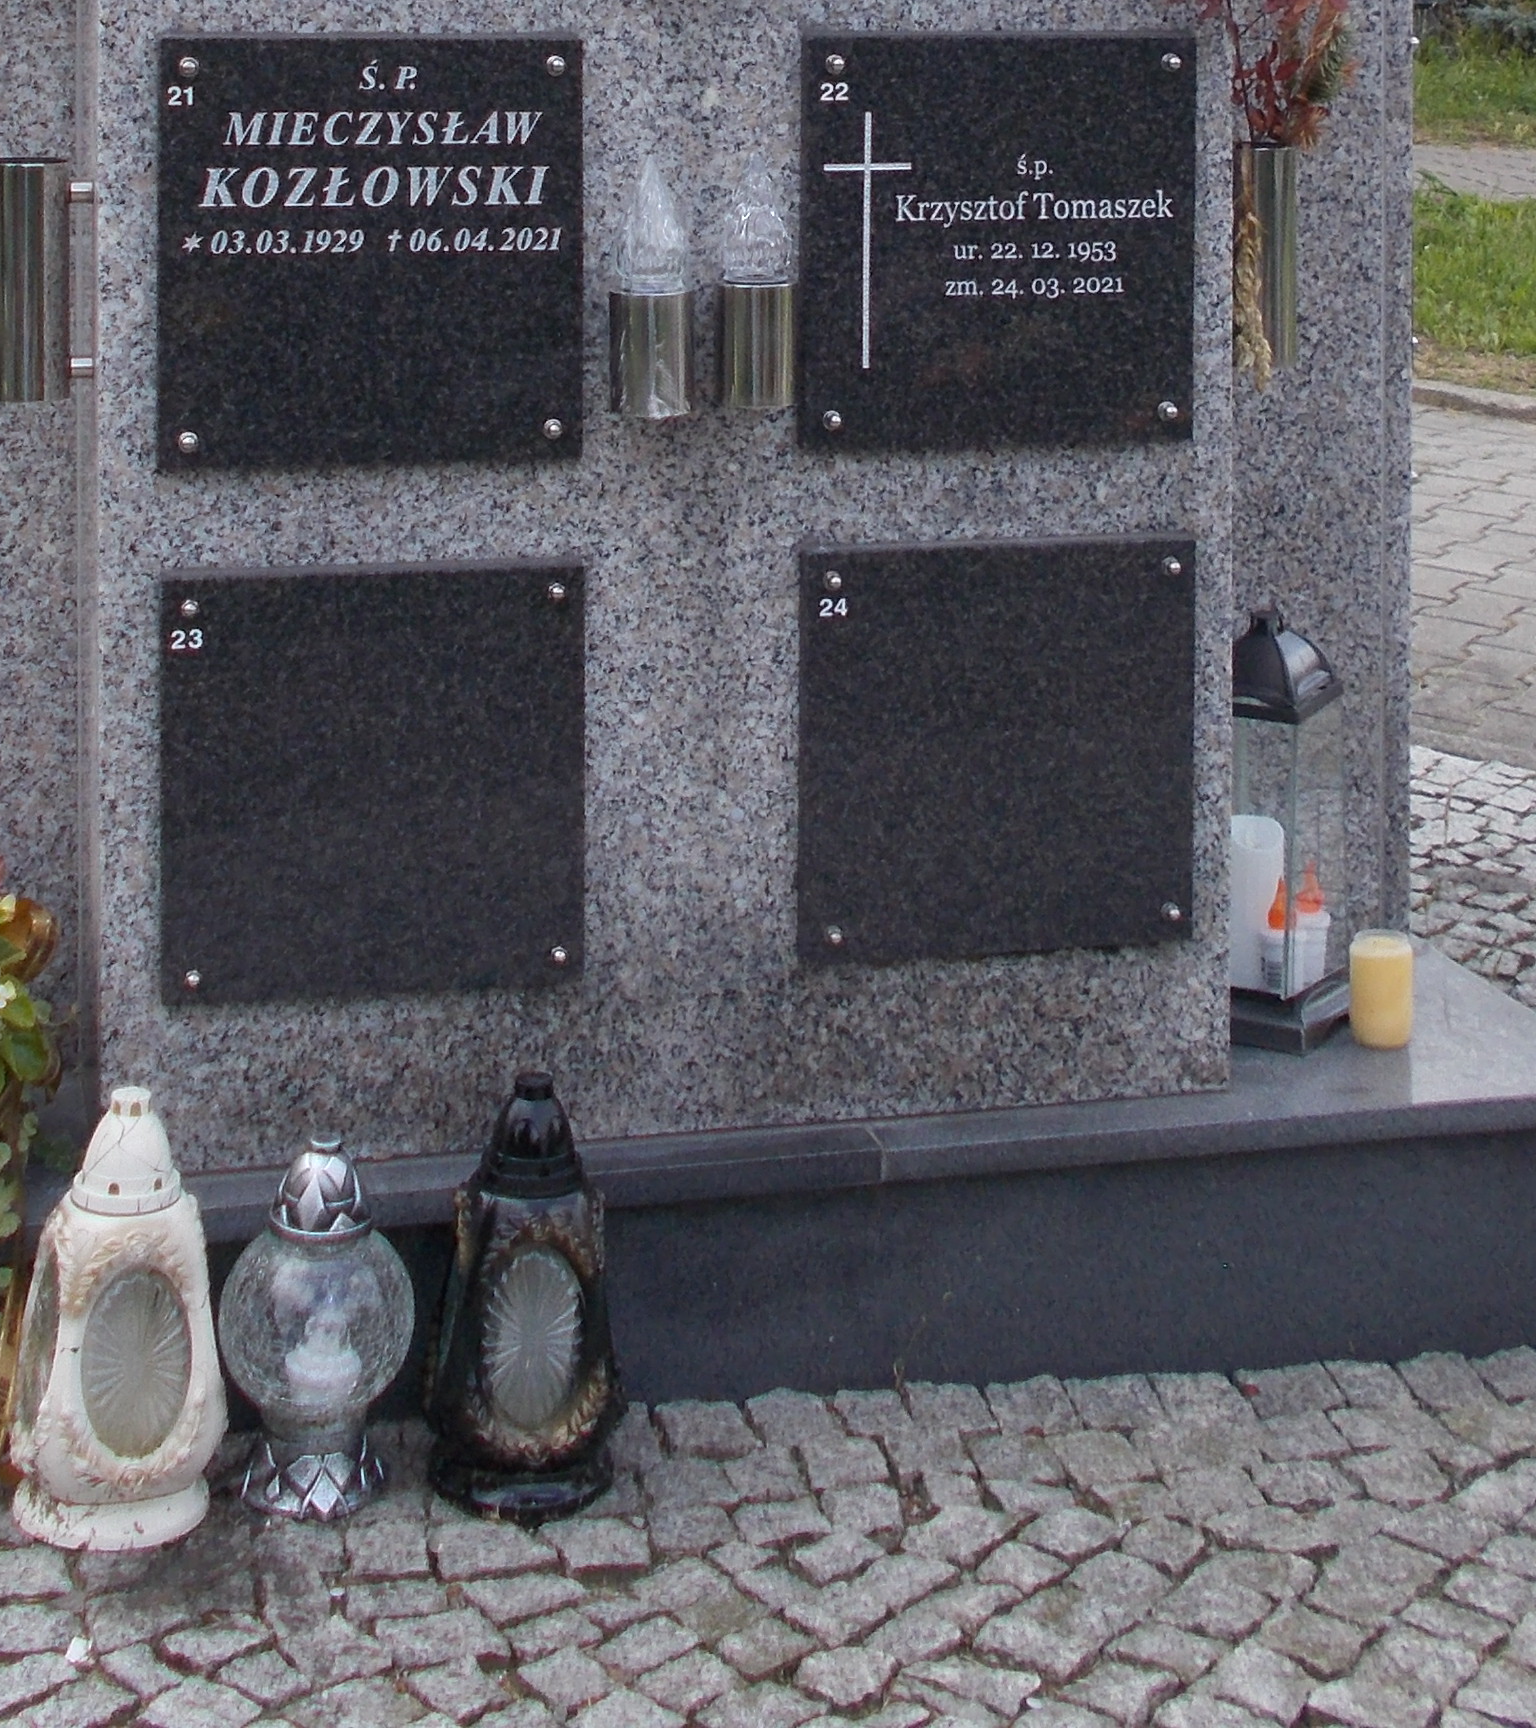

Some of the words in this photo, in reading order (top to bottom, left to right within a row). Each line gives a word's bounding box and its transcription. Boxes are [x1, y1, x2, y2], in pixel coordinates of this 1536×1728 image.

[167, 85, 194, 106] 21
[820, 82, 849, 101] 22
[222, 110, 543, 146] MIECZYSŁAW
[198, 165, 550, 208] KOZŁOWSKI
[895, 190, 1029, 229] Krzysztof
[1032, 189, 1174, 220] Tomaszek
[953, 244, 983, 260] ur.
[945, 280, 984, 296] zm.
[819, 597, 848, 617] 24
[171, 628, 203, 650] 23
